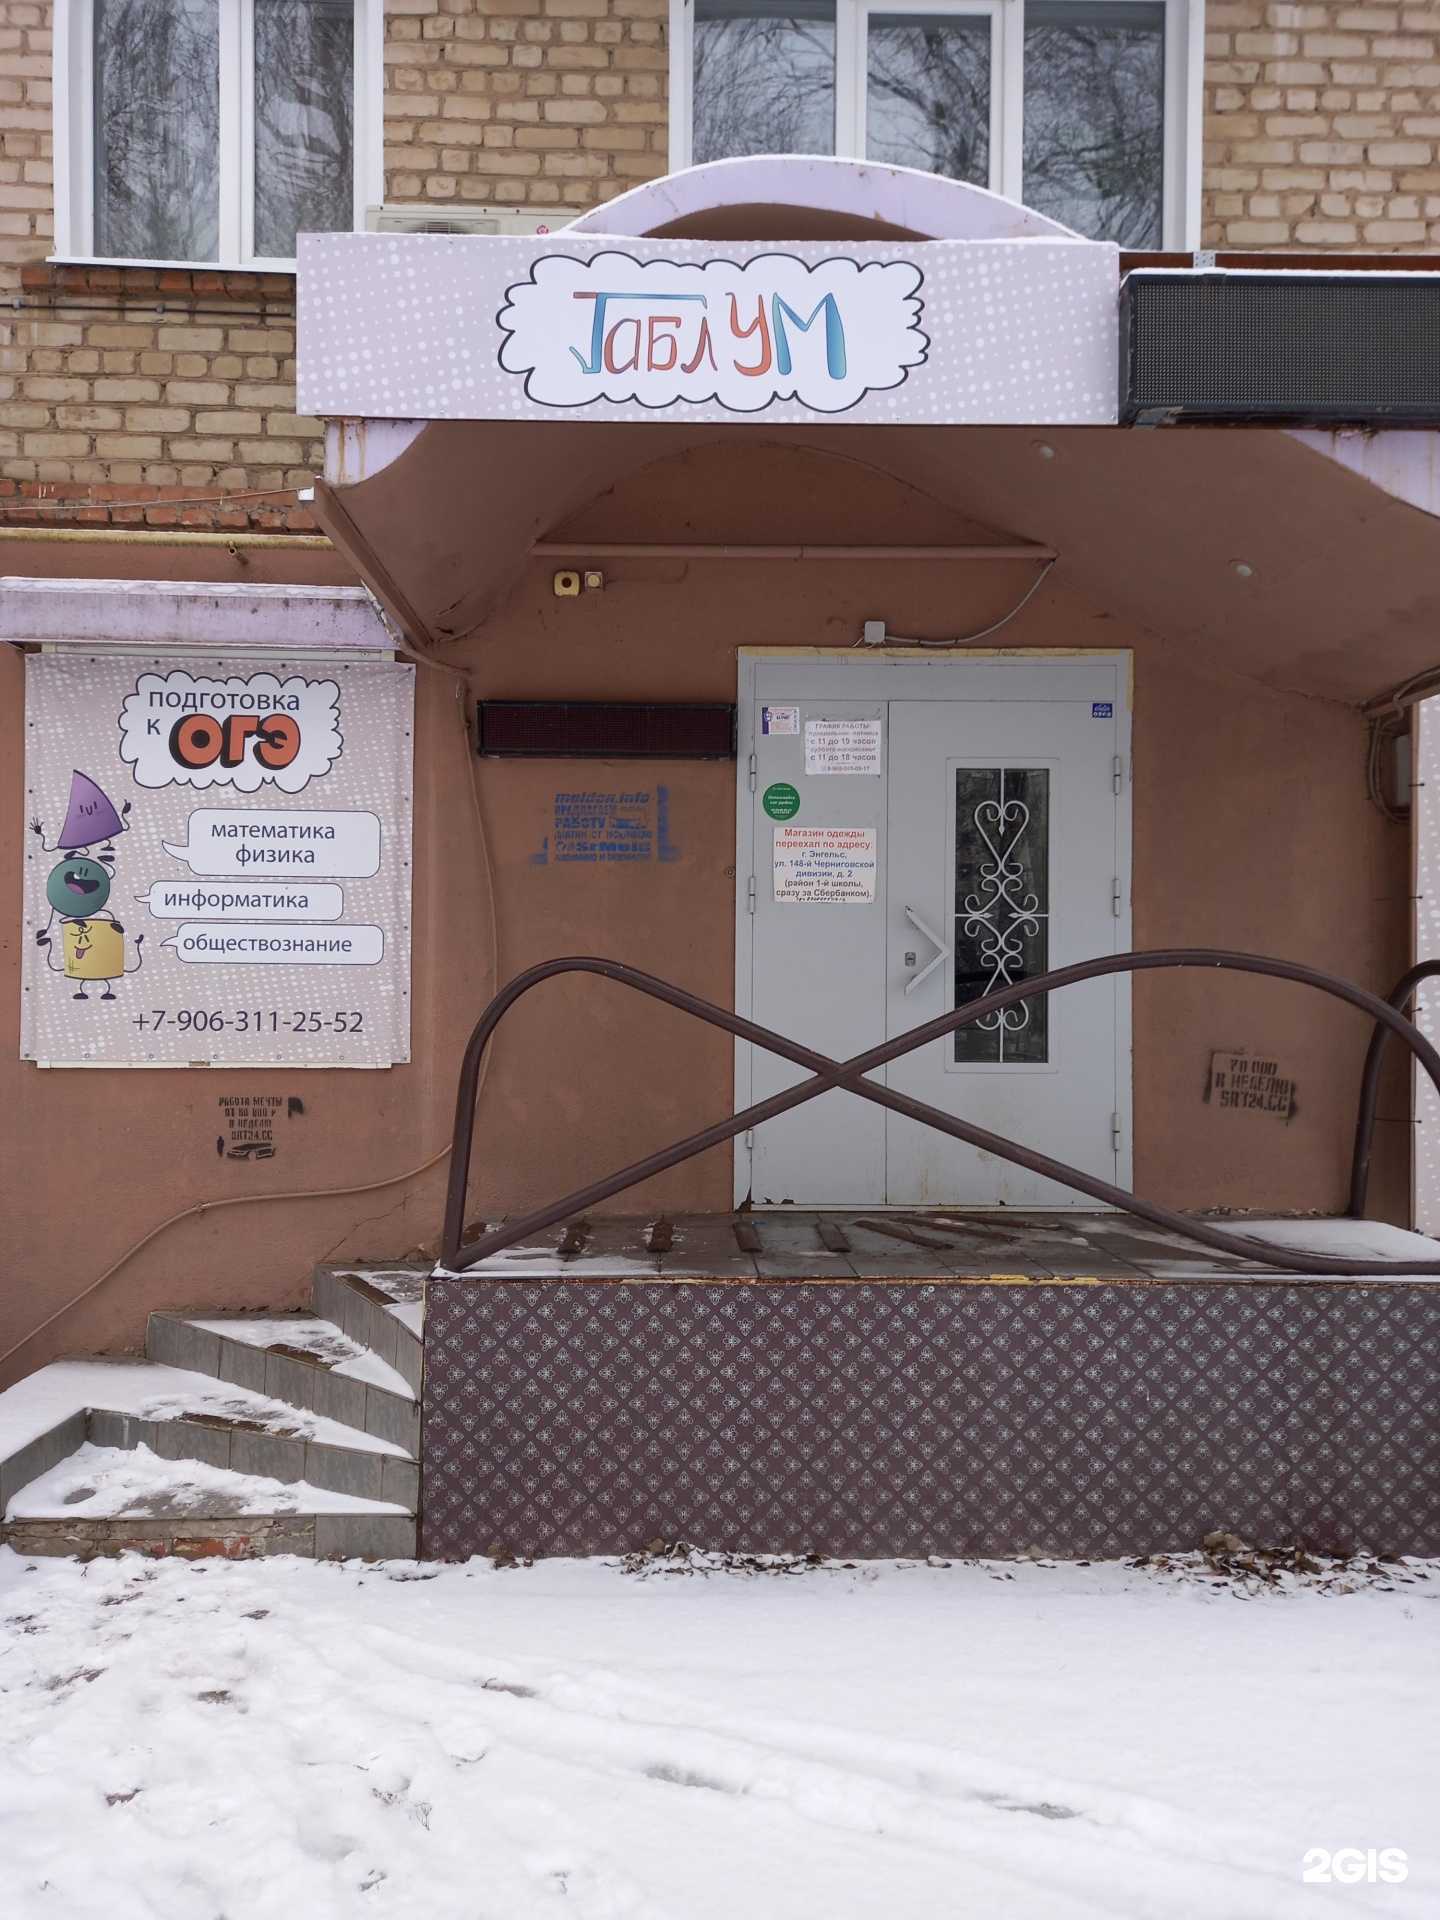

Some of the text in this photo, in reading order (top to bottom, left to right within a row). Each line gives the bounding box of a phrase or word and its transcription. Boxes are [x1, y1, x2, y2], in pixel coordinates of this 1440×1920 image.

[149, 691, 300, 712] подготовка
[147, 713, 301, 770] к ОГЭ
[818, 737, 826, 745] 11
[828, 738, 839, 747] до
[818, 753, 826, 761] 11
[828, 754, 839, 763] до
[211, 823, 335, 840] математика
[784, 828, 865, 839] Магазин одежды
[775, 840, 820, 849] переехал
[823, 840, 834, 848] по
[236, 845, 315, 866] физика
[809, 850, 847, 859] Энгельс,
[774, 859, 875, 869] ул. 148-й Черниговской
[795, 870, 835, 879] дивизии,
[836, 871, 845, 879] д.
[784, 879, 814, 888] (район
[816, 879, 830, 887] 1-й
[776, 889, 800, 899] сразу
[164, 889, 309, 911] информатика
[183, 934, 352, 953] обществознание
[132, 1010, 363, 1033] +7-906-311-25-52
